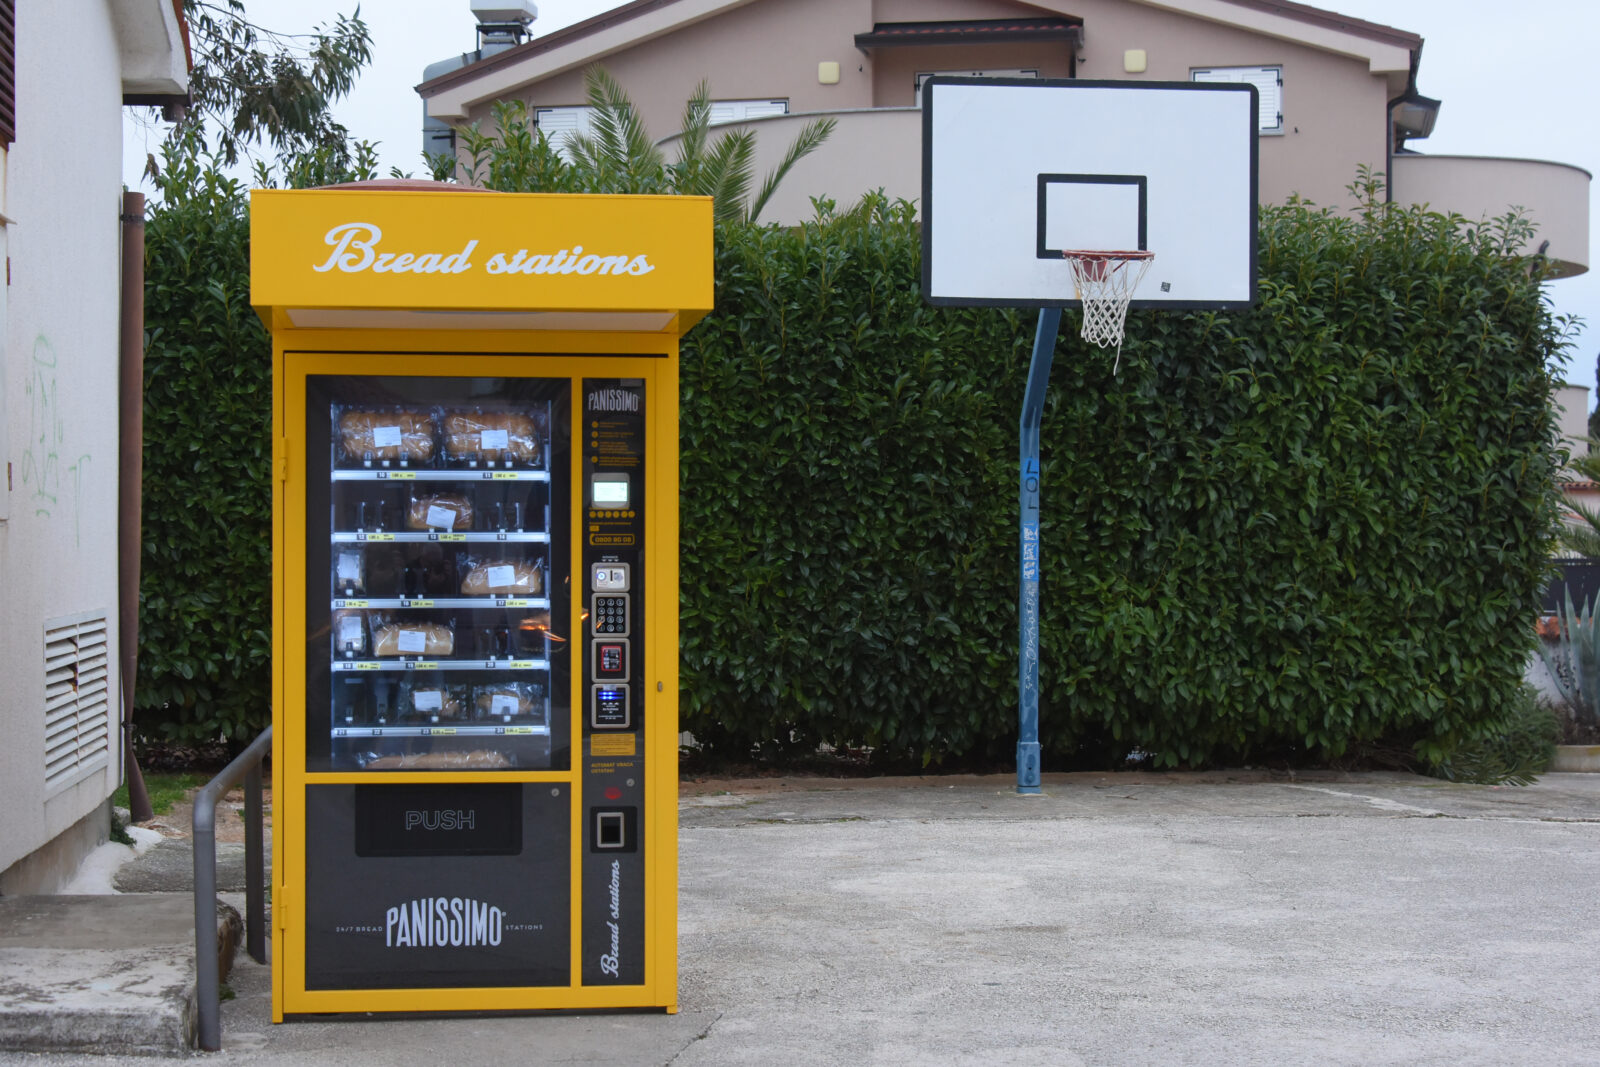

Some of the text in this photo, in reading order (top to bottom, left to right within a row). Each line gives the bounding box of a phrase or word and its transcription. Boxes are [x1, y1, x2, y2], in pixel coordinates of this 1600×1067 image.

[312, 222, 655, 277] Bread stations
[588, 389, 640, 412] PANISSIMO
[405, 810, 475, 830] PUSH
[386, 897, 502, 947] PANISSIMO
[600, 859, 620, 978] Bread stations
